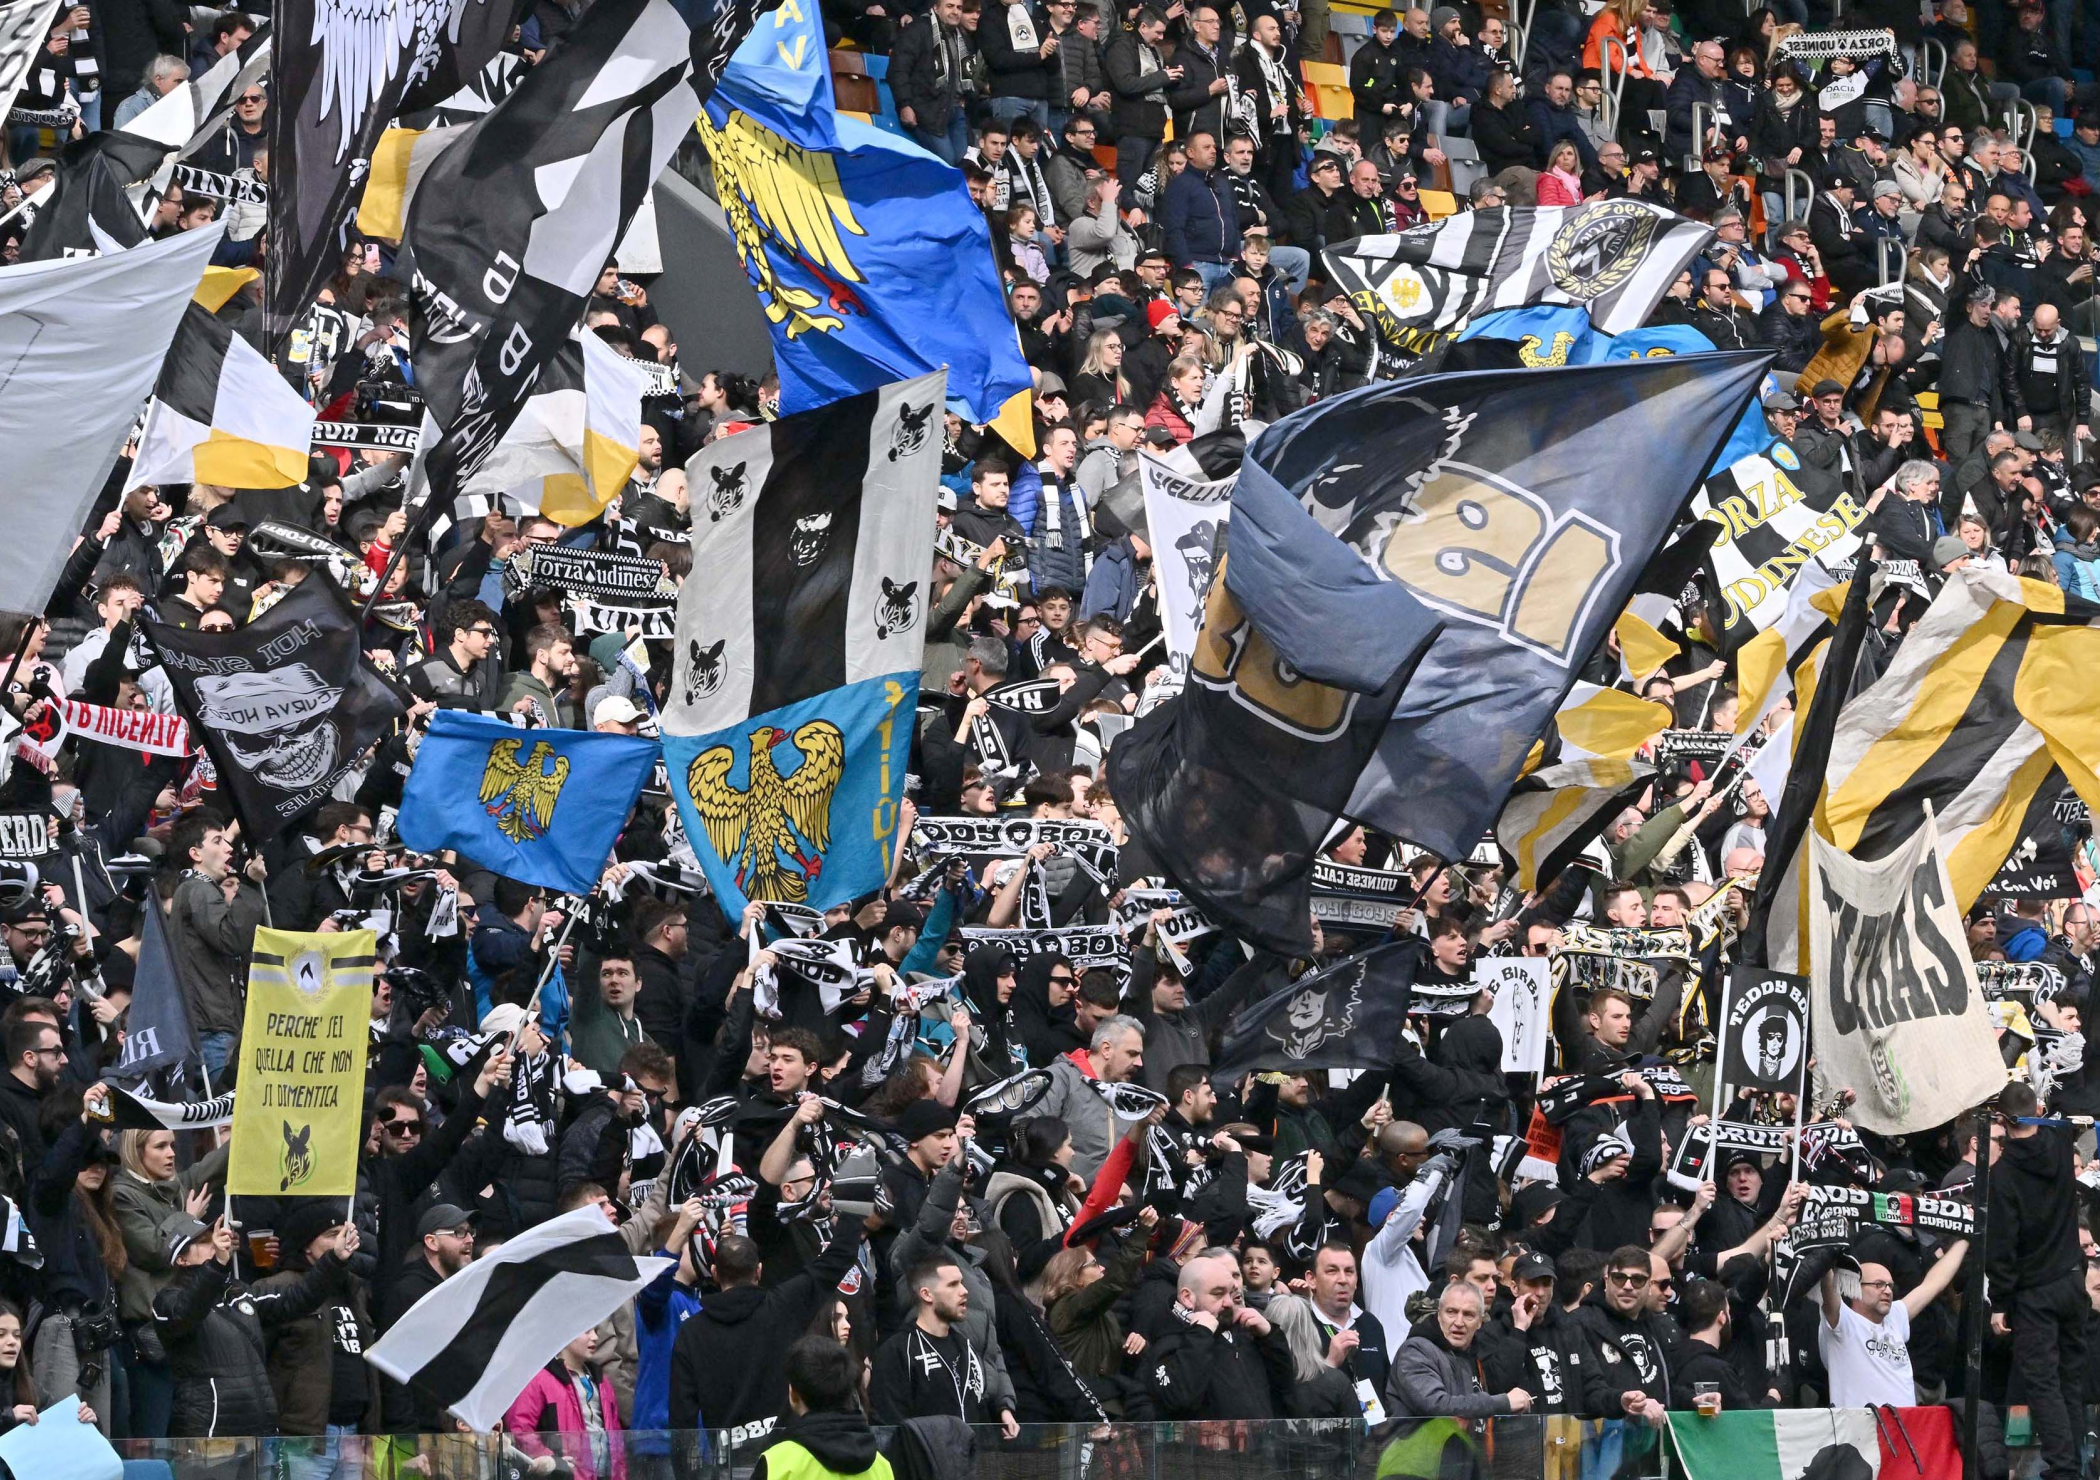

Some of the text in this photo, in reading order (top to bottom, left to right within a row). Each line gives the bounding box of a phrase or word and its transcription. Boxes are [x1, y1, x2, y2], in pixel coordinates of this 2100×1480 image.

[1826, 84, 1856, 93] DACIA
[531, 552, 658, 589] forza udinese
[1729, 980, 1788, 1026] TEDDY
[266, 1011, 344, 1039] PERCHE' SEI
[255, 1047, 353, 1076] QUELLA CHE NON
[262, 1083, 339, 1109] SI DIMENTICA
[1919, 1215, 1963, 1232] CURVA
